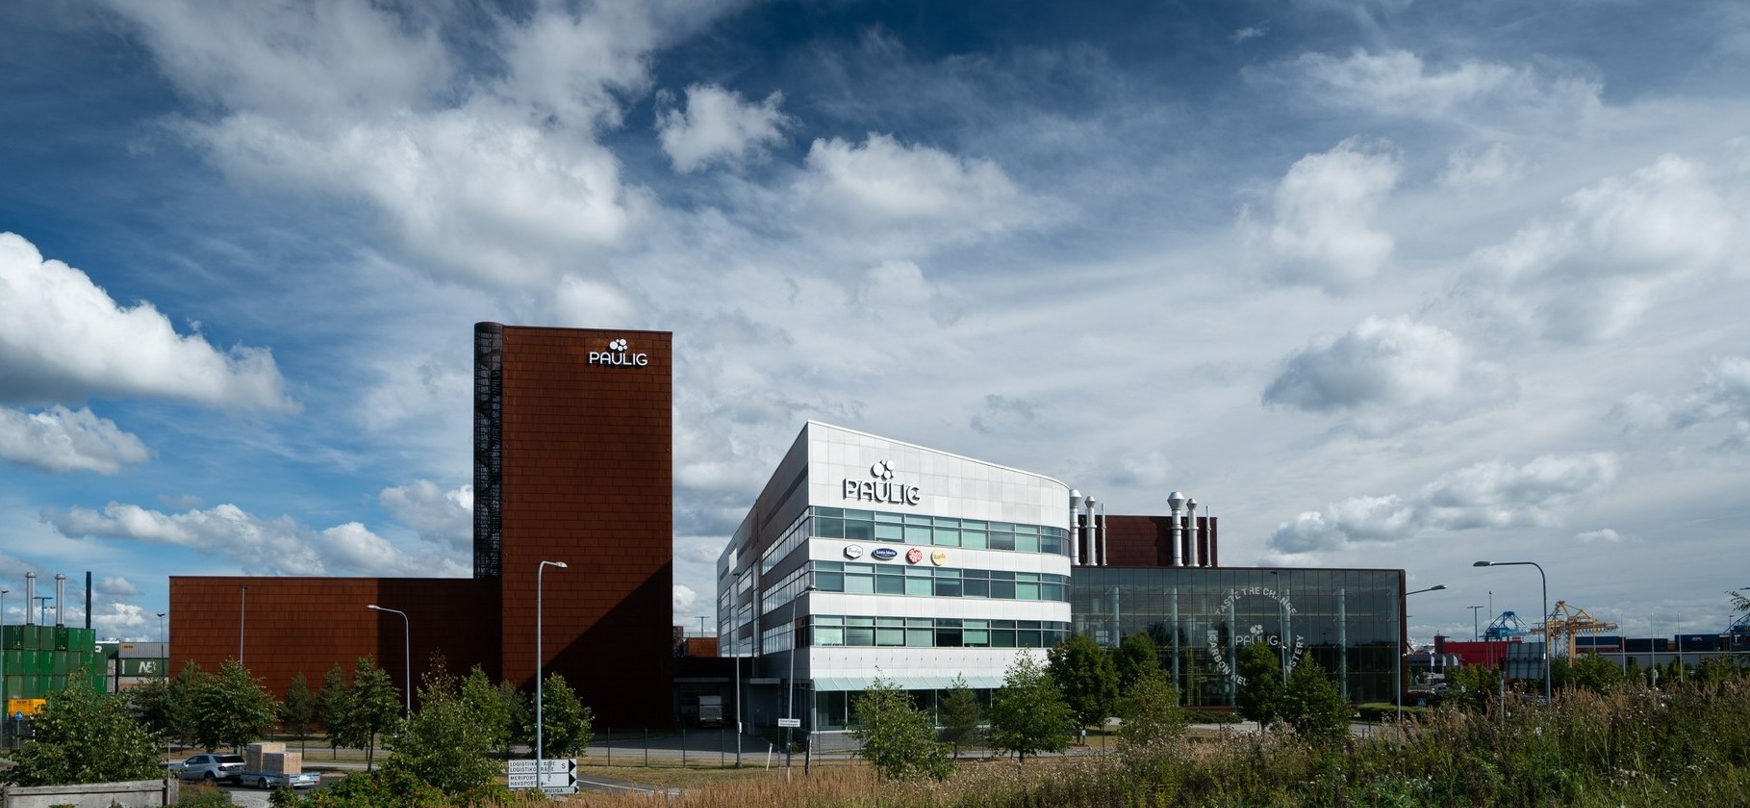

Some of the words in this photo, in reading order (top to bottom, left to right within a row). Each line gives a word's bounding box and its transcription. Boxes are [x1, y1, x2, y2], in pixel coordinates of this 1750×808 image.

[589, 351, 648, 366] PAULIG
[843, 478, 921, 505] PAULIG
[1215, 591, 1241, 615] TASTE
[1241, 586, 1260, 596] THE
[1262, 587, 1297, 614] CHANGE
[1208, 634, 1232, 675] CARBON
